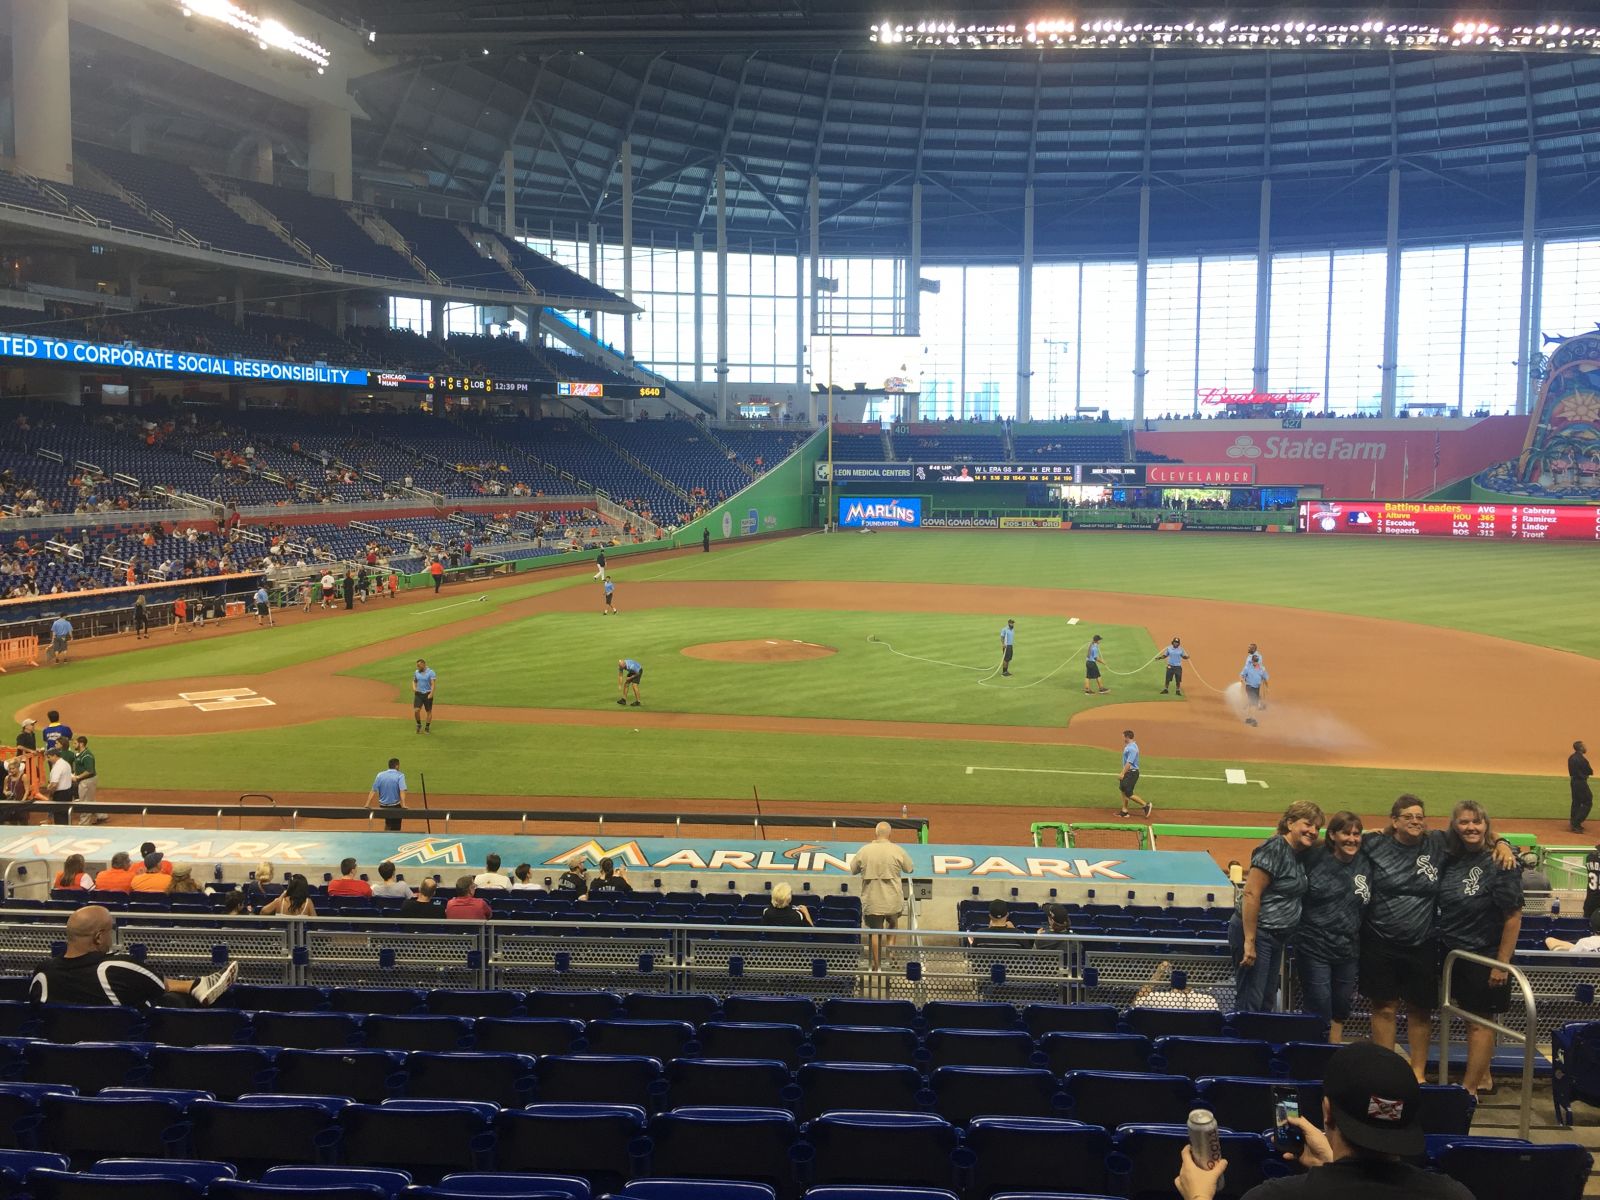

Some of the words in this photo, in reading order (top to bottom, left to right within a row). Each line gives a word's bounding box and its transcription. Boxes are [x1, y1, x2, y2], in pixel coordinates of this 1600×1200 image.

[0, 336, 38, 356] TED
[43, 341, 68, 359] TO
[73, 344, 174, 369] CORPORATE
[178, 355, 230, 375] SOCIAL
[234, 361, 350, 383] RESPONSIBILITY
[440, 379, 446, 387] H
[470, 381, 485, 389] LOB
[640, 388, 660, 396] $640
[1150, 467, 1248, 482] CLEVELANDER
[845, 500, 915, 523] MARLINS
[1384, 503, 1420, 514] Batting
[1423, 504, 1462, 513] Leaders
[1385, 527, 1420, 535] Bogaerts
[542, 839, 855, 872] MARLIN
[930, 855, 1135, 880] PARK
